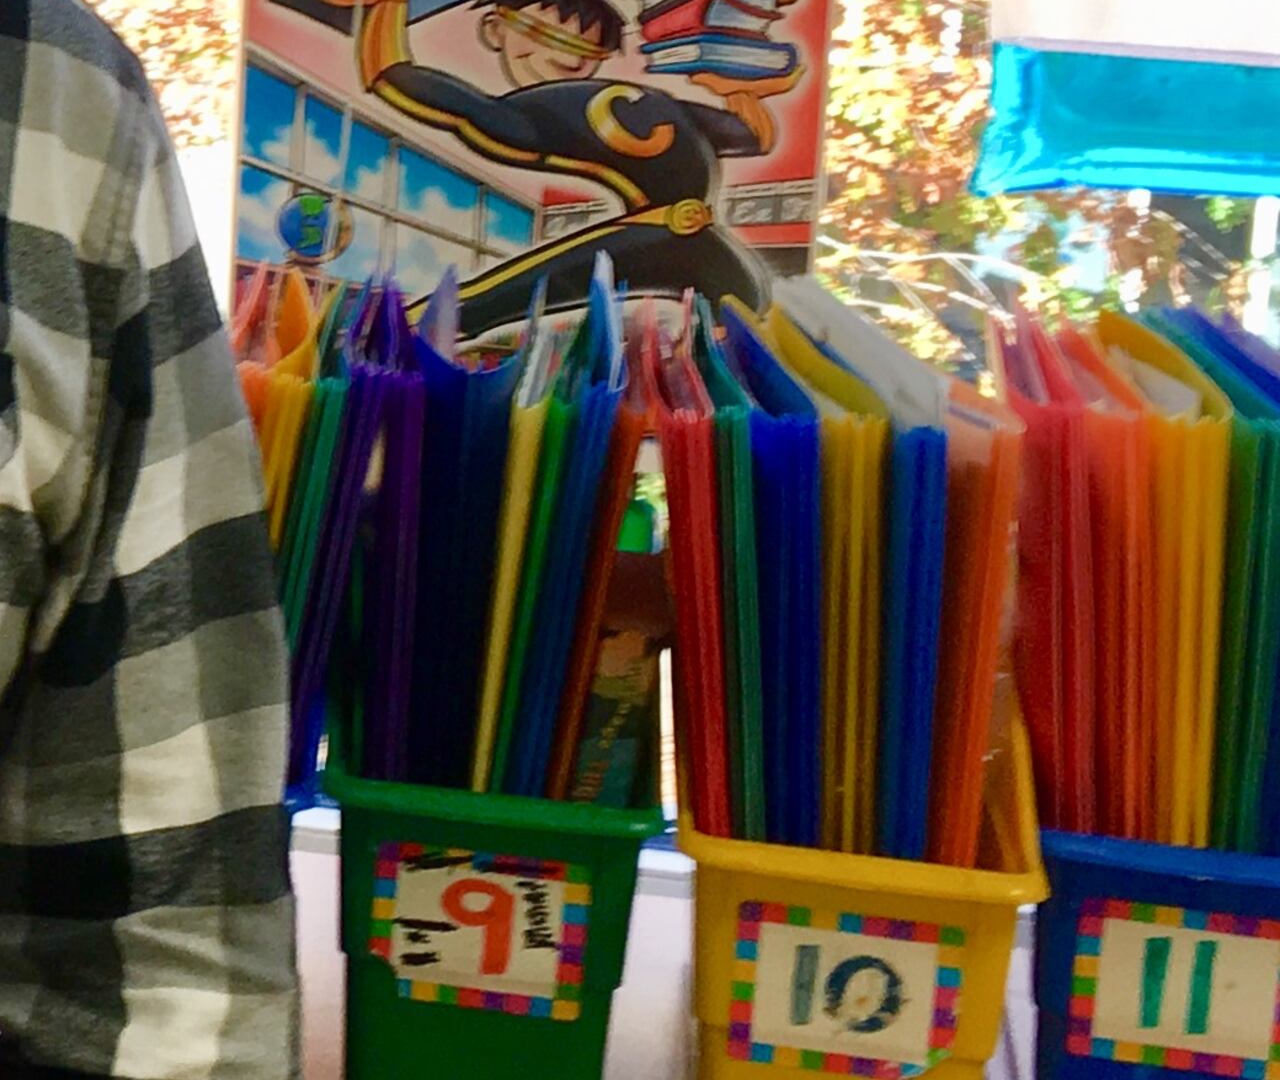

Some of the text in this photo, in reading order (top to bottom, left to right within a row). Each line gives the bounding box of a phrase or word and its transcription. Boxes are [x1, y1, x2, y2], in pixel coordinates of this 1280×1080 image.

[441, 877, 516, 976] 9
[790, 943, 904, 1033] 10
[1138, 936, 1218, 1035] 11
